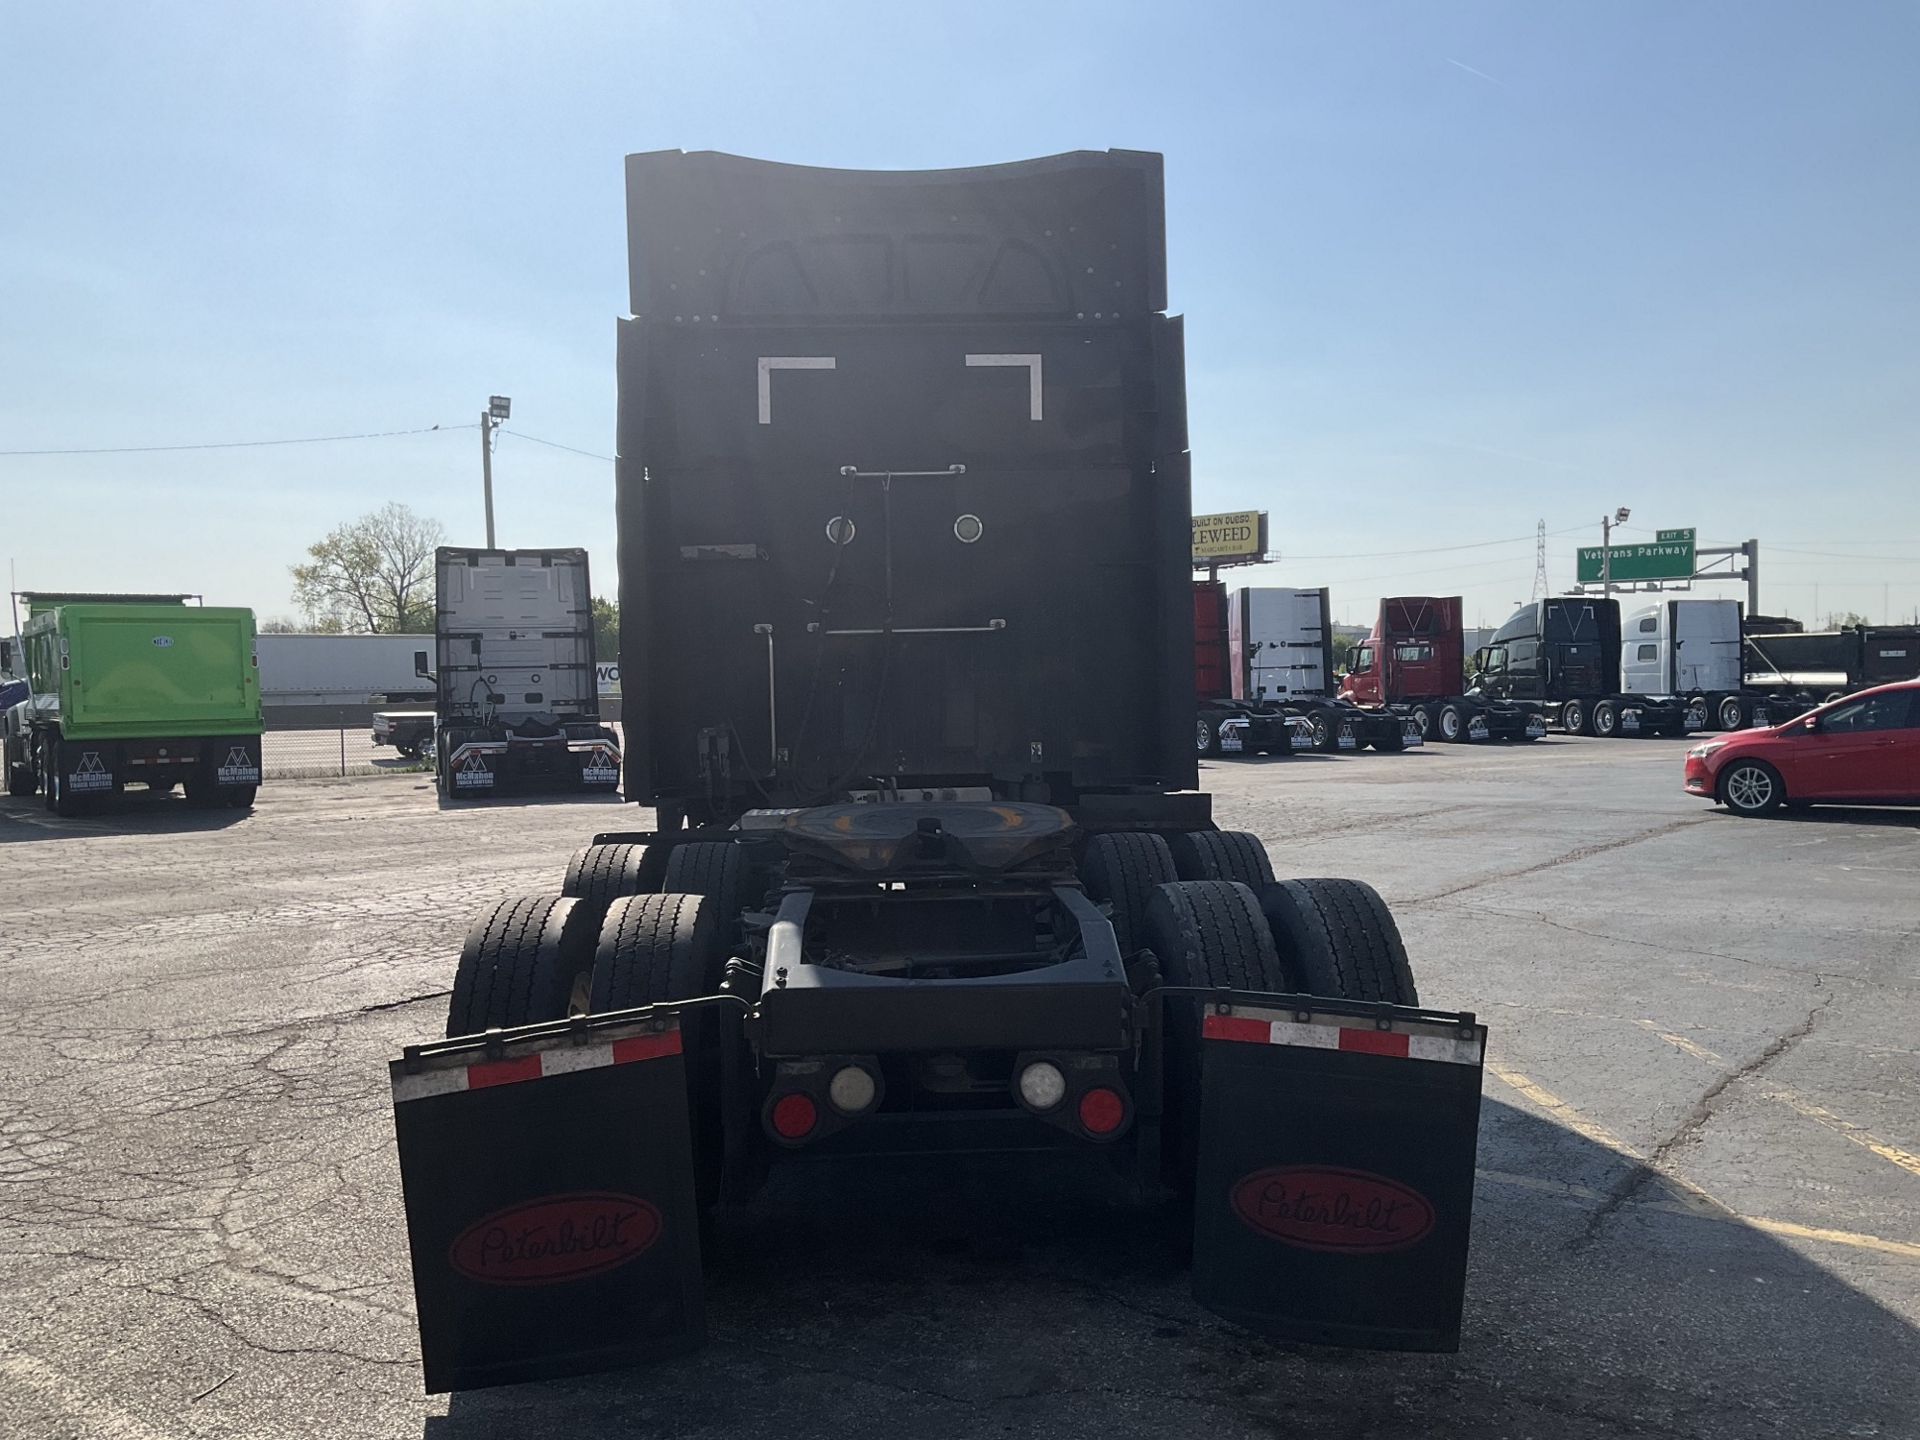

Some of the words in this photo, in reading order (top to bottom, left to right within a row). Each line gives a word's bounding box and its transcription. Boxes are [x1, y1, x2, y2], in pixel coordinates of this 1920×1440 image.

[1213, 517, 1223, 526] ON
[1661, 532, 1677, 540] EXIT
[1683, 530, 1690, 539] 5
[1638, 546, 1688, 556] Parkway
[217, 767, 259, 776] McMahon
[456, 772, 494, 780] McMahon
[69, 773, 112, 782] McMahon
[1258, 1181, 1411, 1232] Peterbilt
[481, 1211, 638, 1267] Peterbilt
